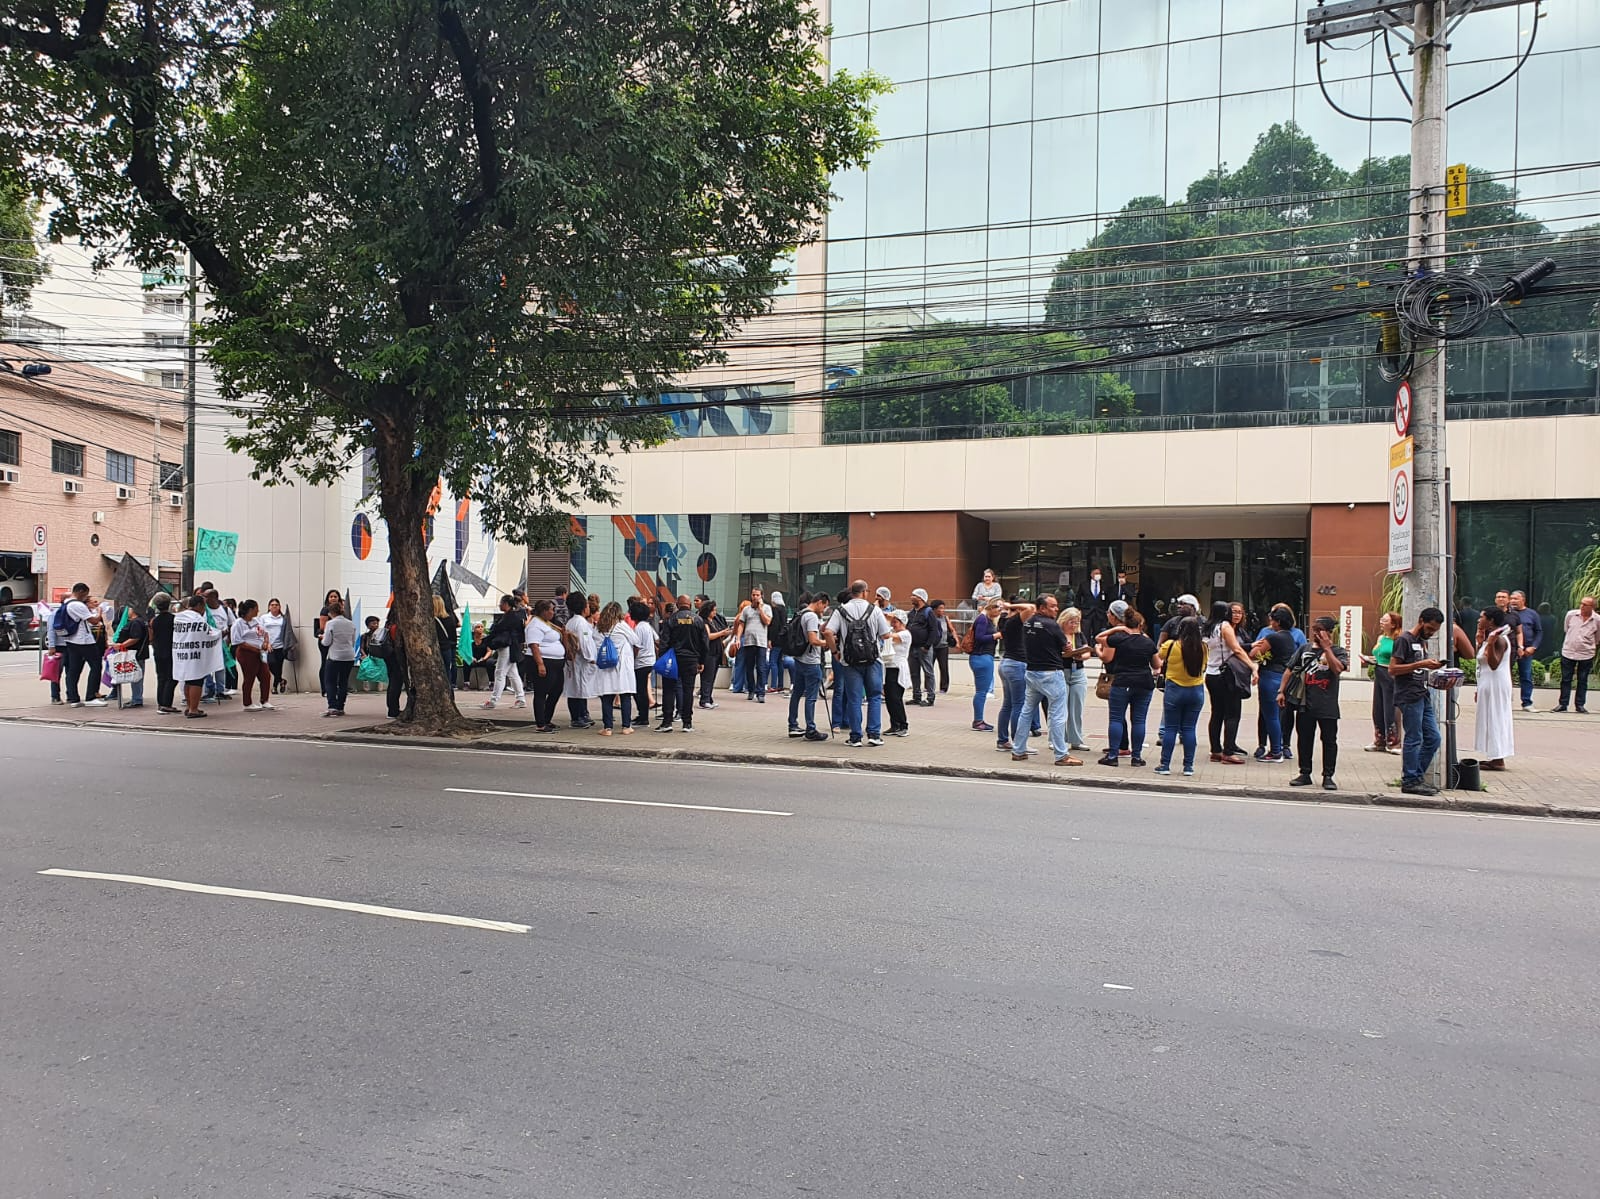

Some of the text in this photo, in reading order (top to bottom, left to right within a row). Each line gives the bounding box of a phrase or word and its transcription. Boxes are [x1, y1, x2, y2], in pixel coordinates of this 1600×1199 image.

[1396, 482, 1406, 507] 60
[37, 530, 43, 542] E
[199, 530, 237, 557] LUTO
